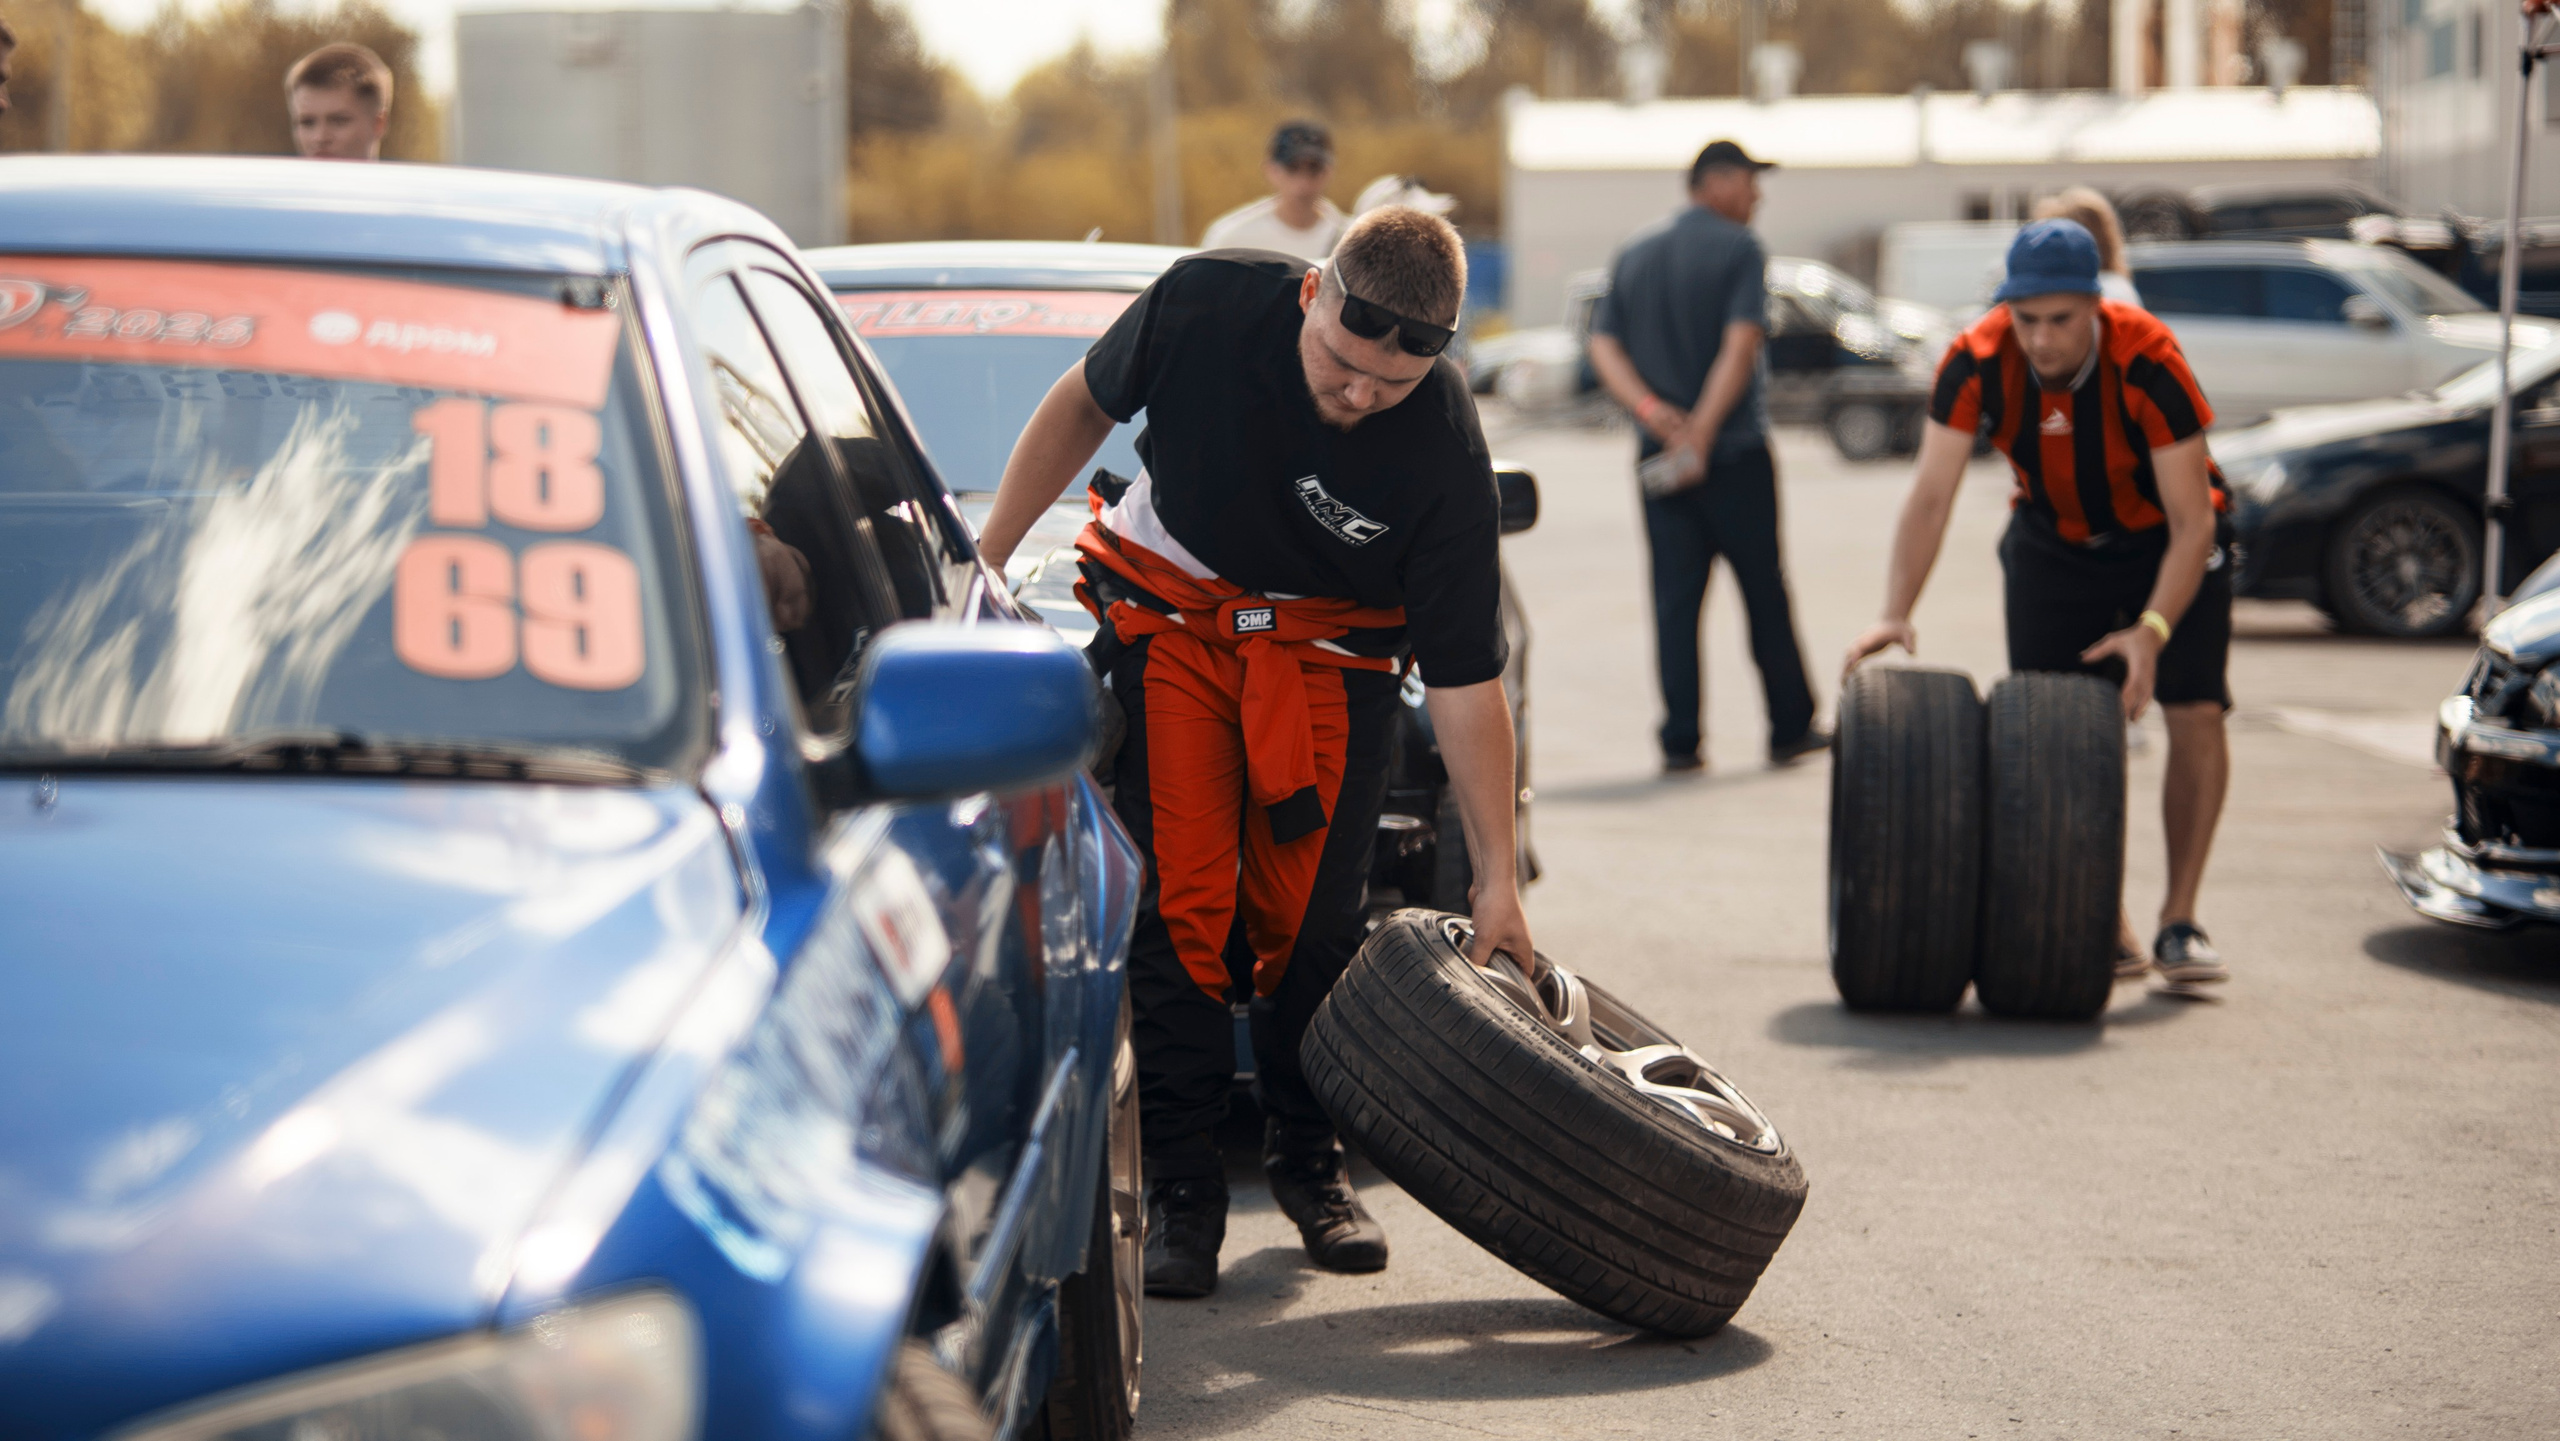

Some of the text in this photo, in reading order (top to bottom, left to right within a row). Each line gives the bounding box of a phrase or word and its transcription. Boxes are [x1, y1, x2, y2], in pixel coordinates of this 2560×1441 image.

[411, 399, 606, 532] 18
[394, 534, 644, 690] 69
[1237, 612, 1272, 627] OMP
